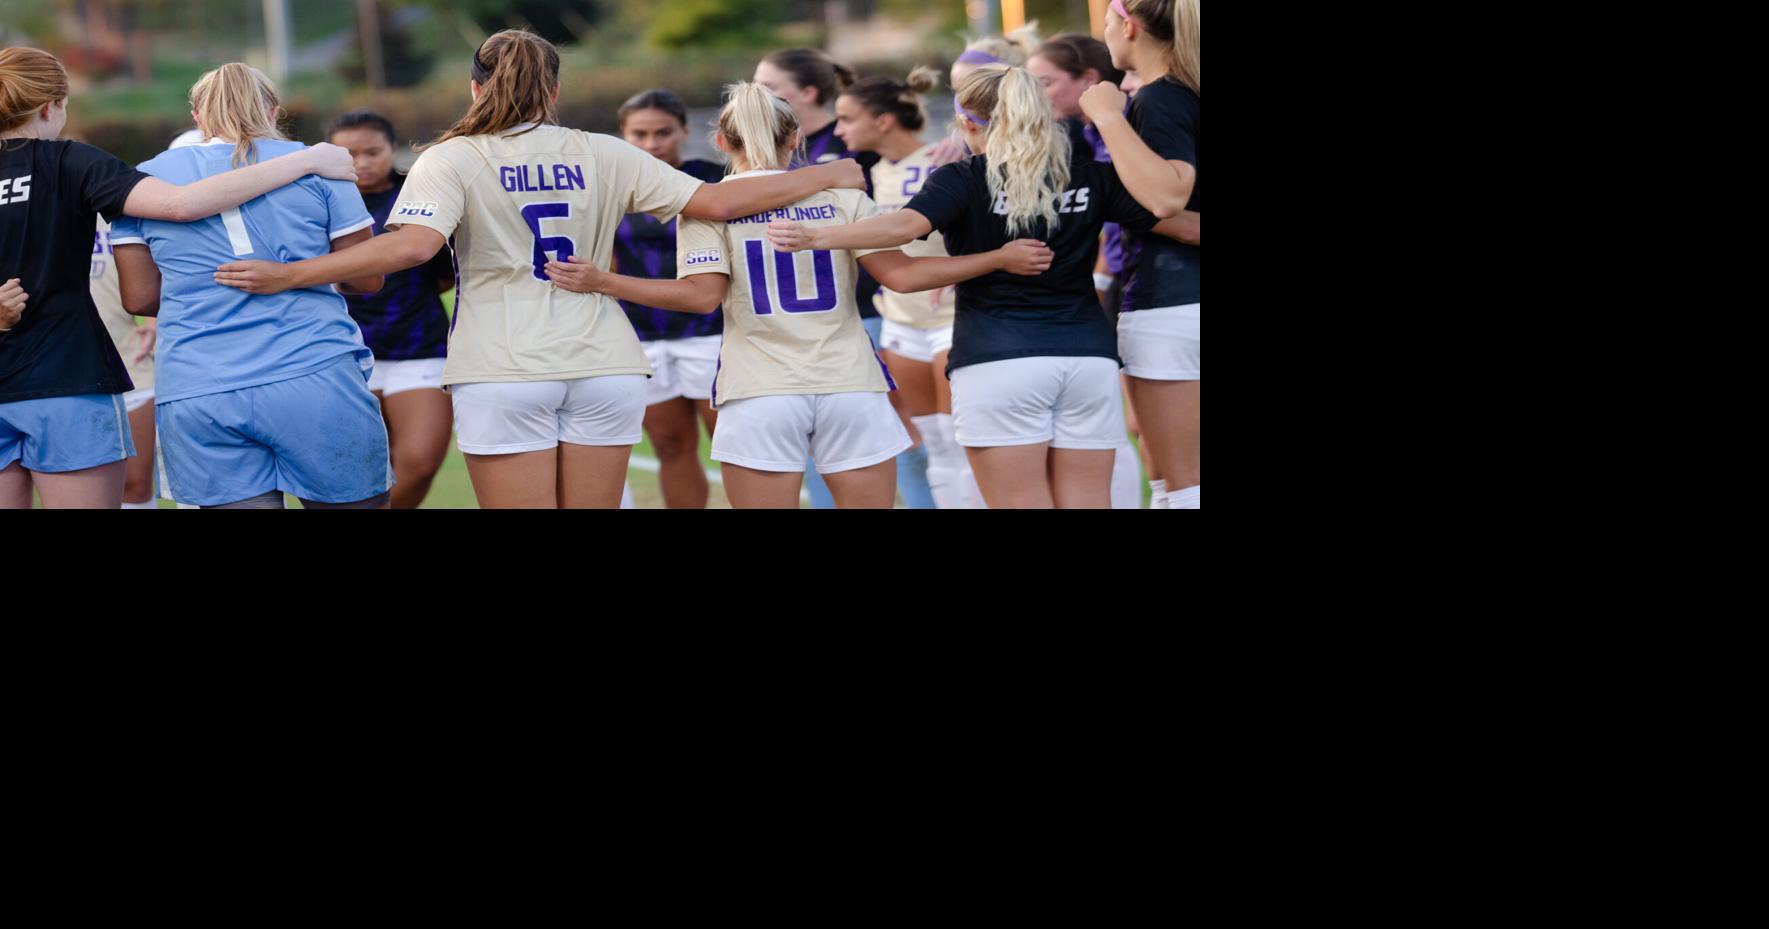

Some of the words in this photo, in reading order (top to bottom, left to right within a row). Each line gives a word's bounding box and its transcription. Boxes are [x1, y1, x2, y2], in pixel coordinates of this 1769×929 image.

[500, 164, 586, 192] GILLEN
[902, 166, 938, 196] 2
[726, 204, 836, 225] ANDERLINDEN
[993, 187, 1090, 215] DES
[520, 202, 575, 282] 6
[743, 238, 839, 316] 10
